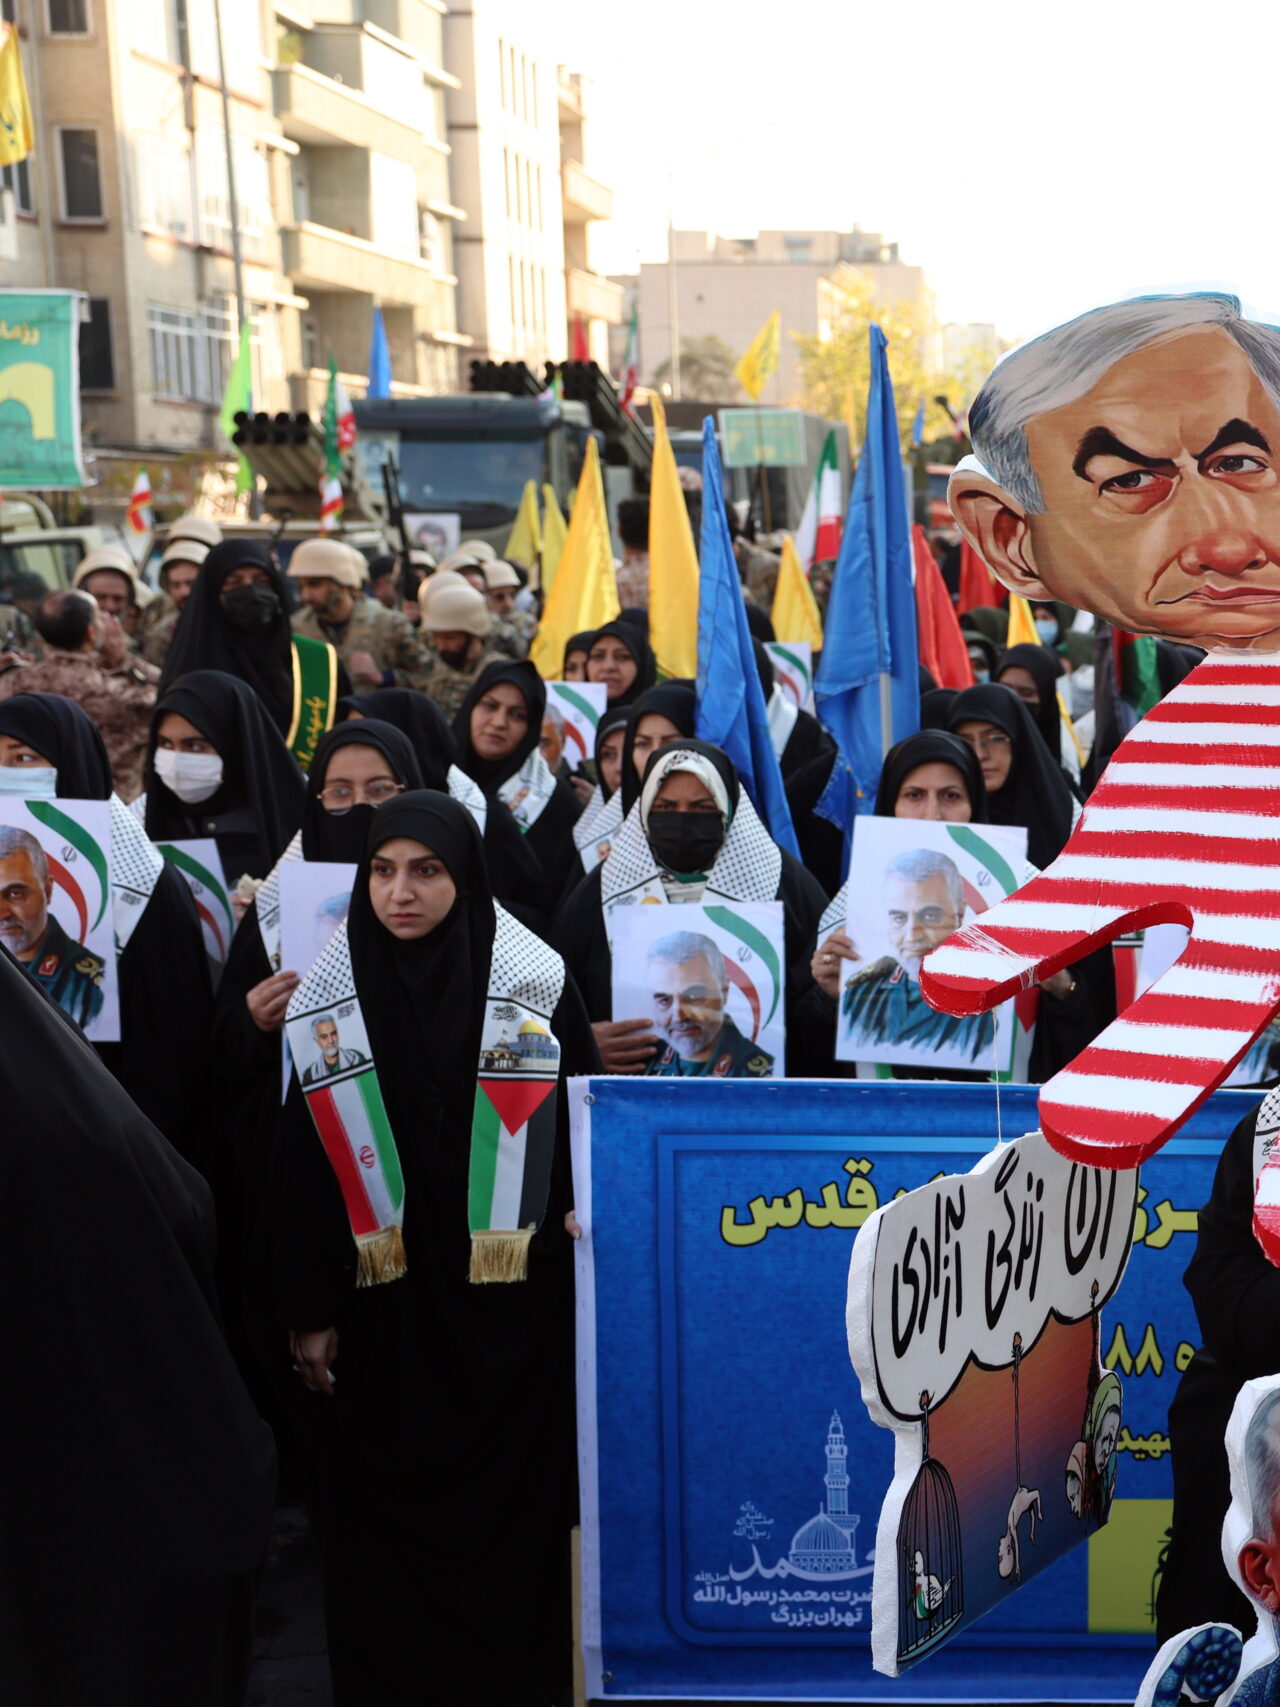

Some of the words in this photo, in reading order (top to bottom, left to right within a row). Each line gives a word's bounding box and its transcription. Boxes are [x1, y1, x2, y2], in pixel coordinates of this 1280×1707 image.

[720, 1156, 878, 1247] قدس
[771, 1604, 814, 1627] بزرگ
[814, 1606, 863, 1627] تهران
